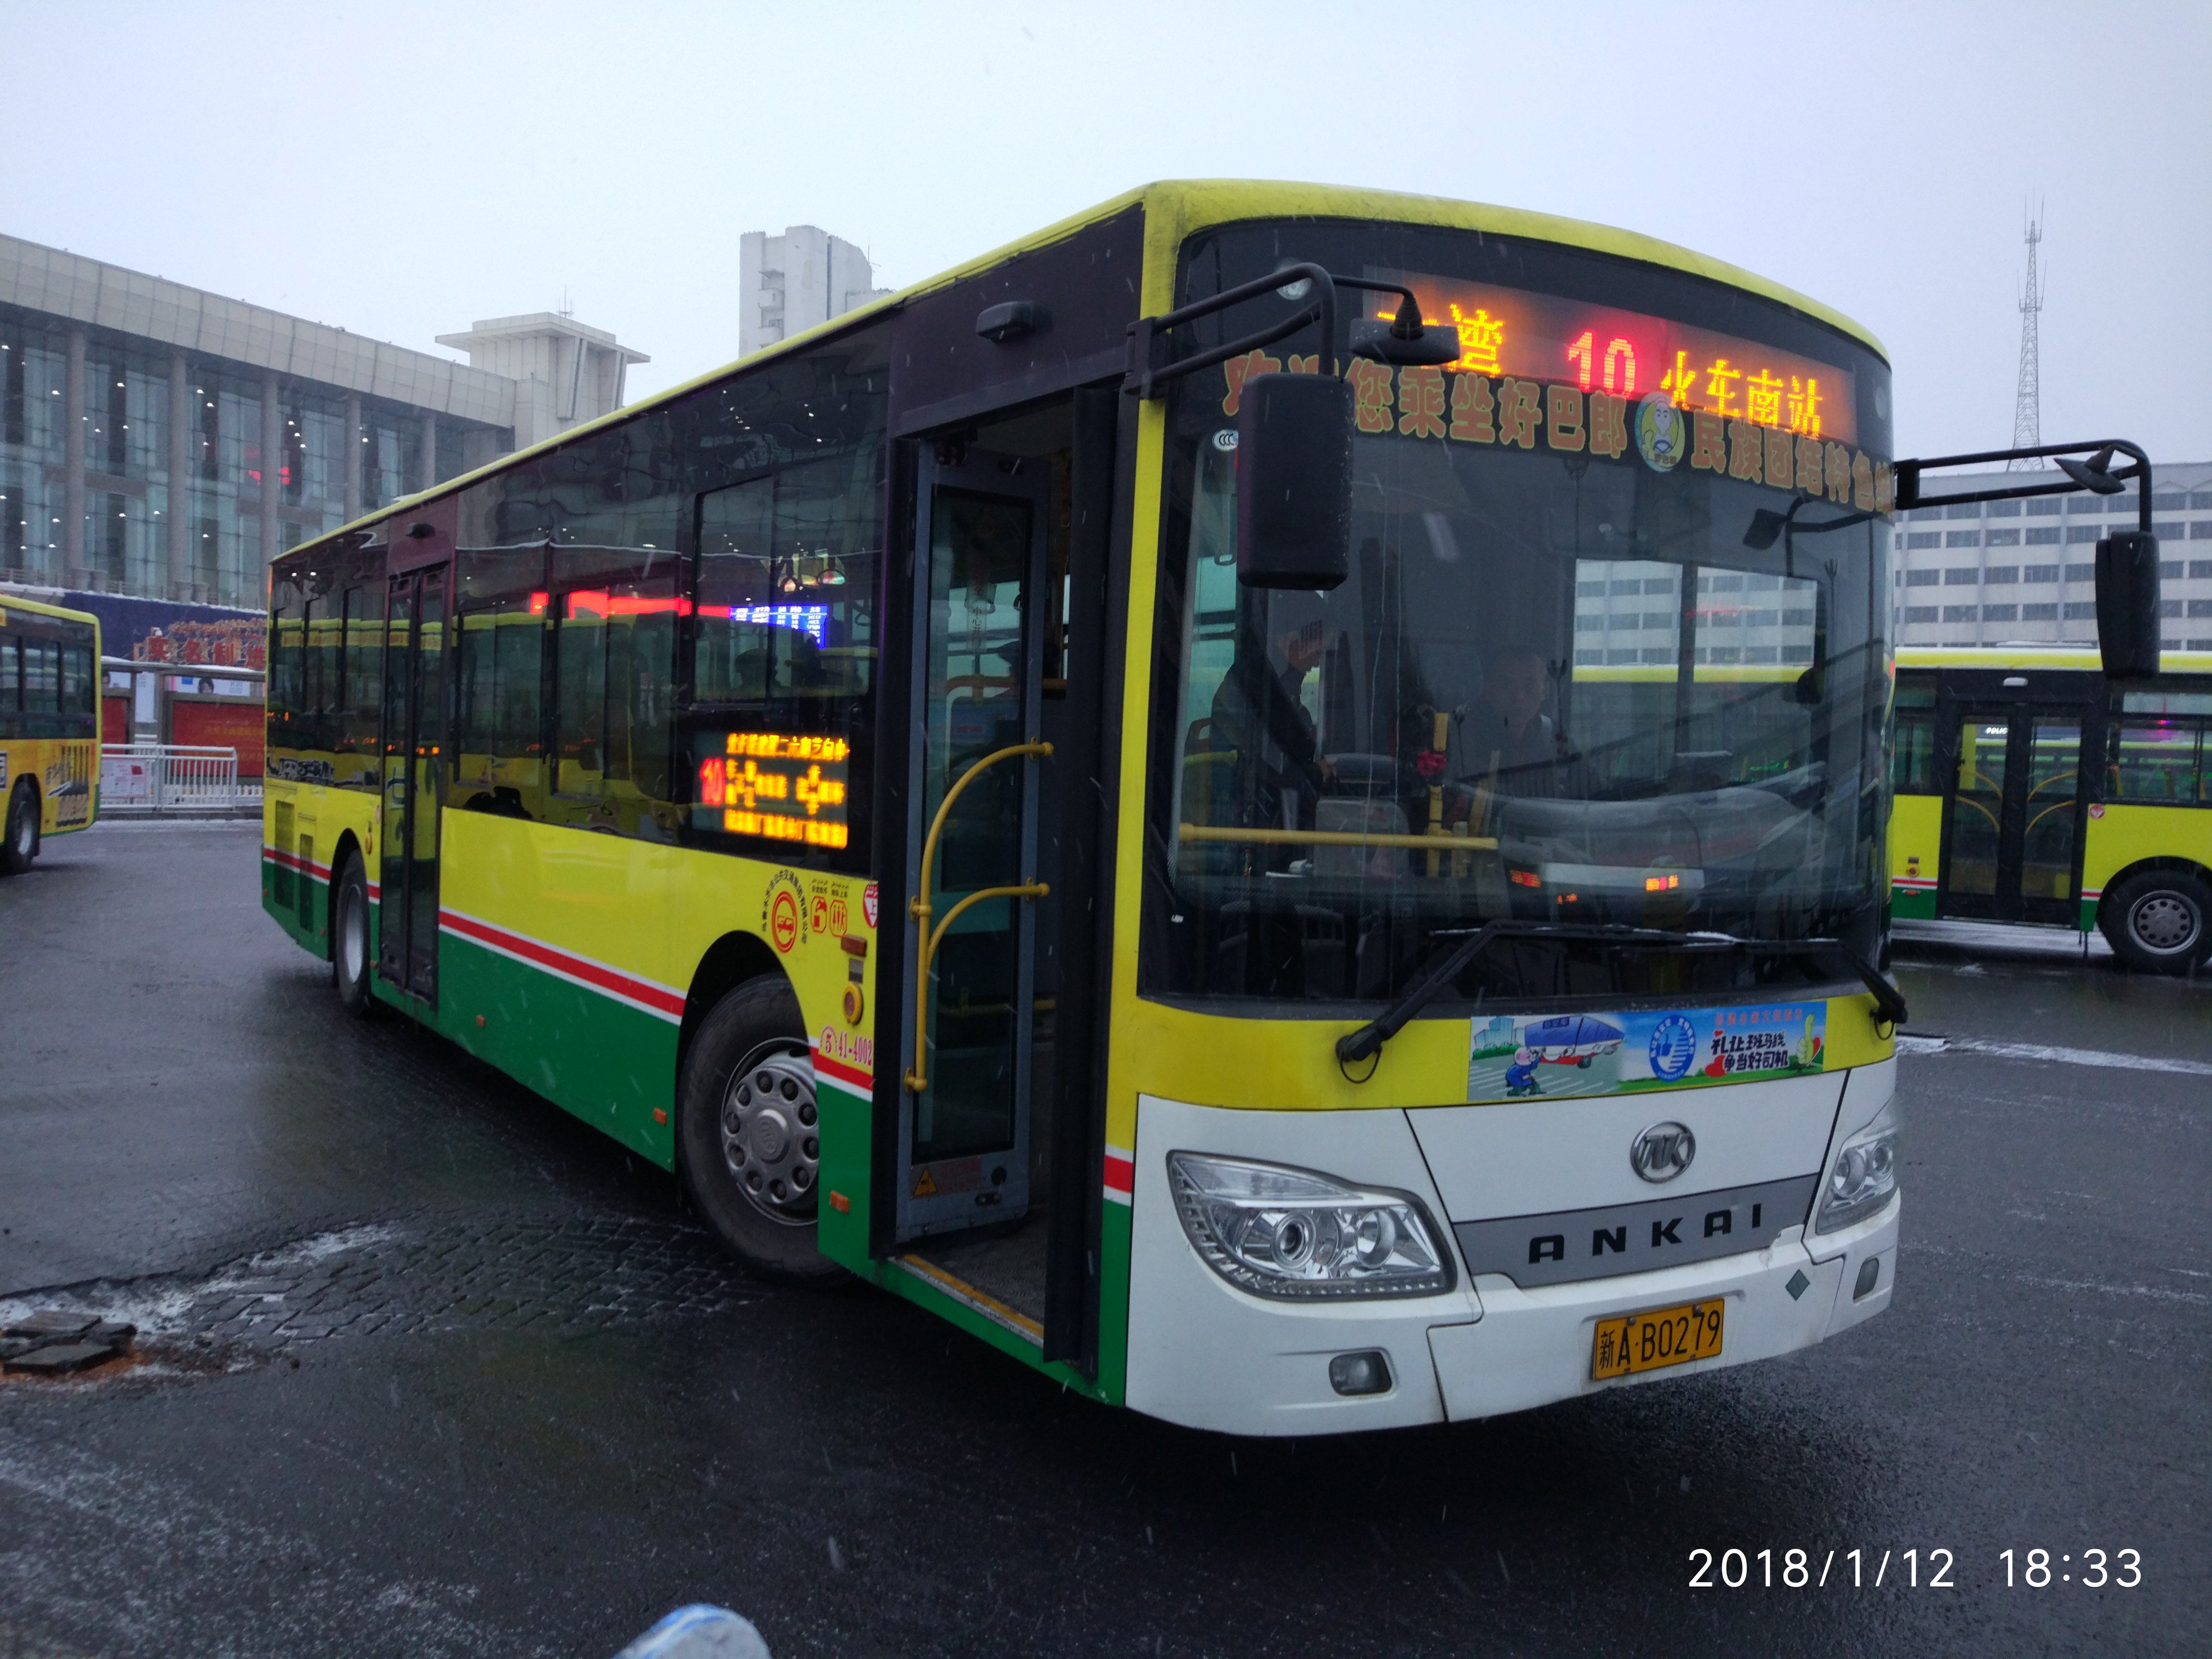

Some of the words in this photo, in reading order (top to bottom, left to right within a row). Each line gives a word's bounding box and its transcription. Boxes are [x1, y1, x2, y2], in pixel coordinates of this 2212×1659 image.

[1568, 331, 1636, 399] 10
[1661, 351, 1823, 440] 火车南站
[1528, 1203, 1762, 1264] ANKAI
